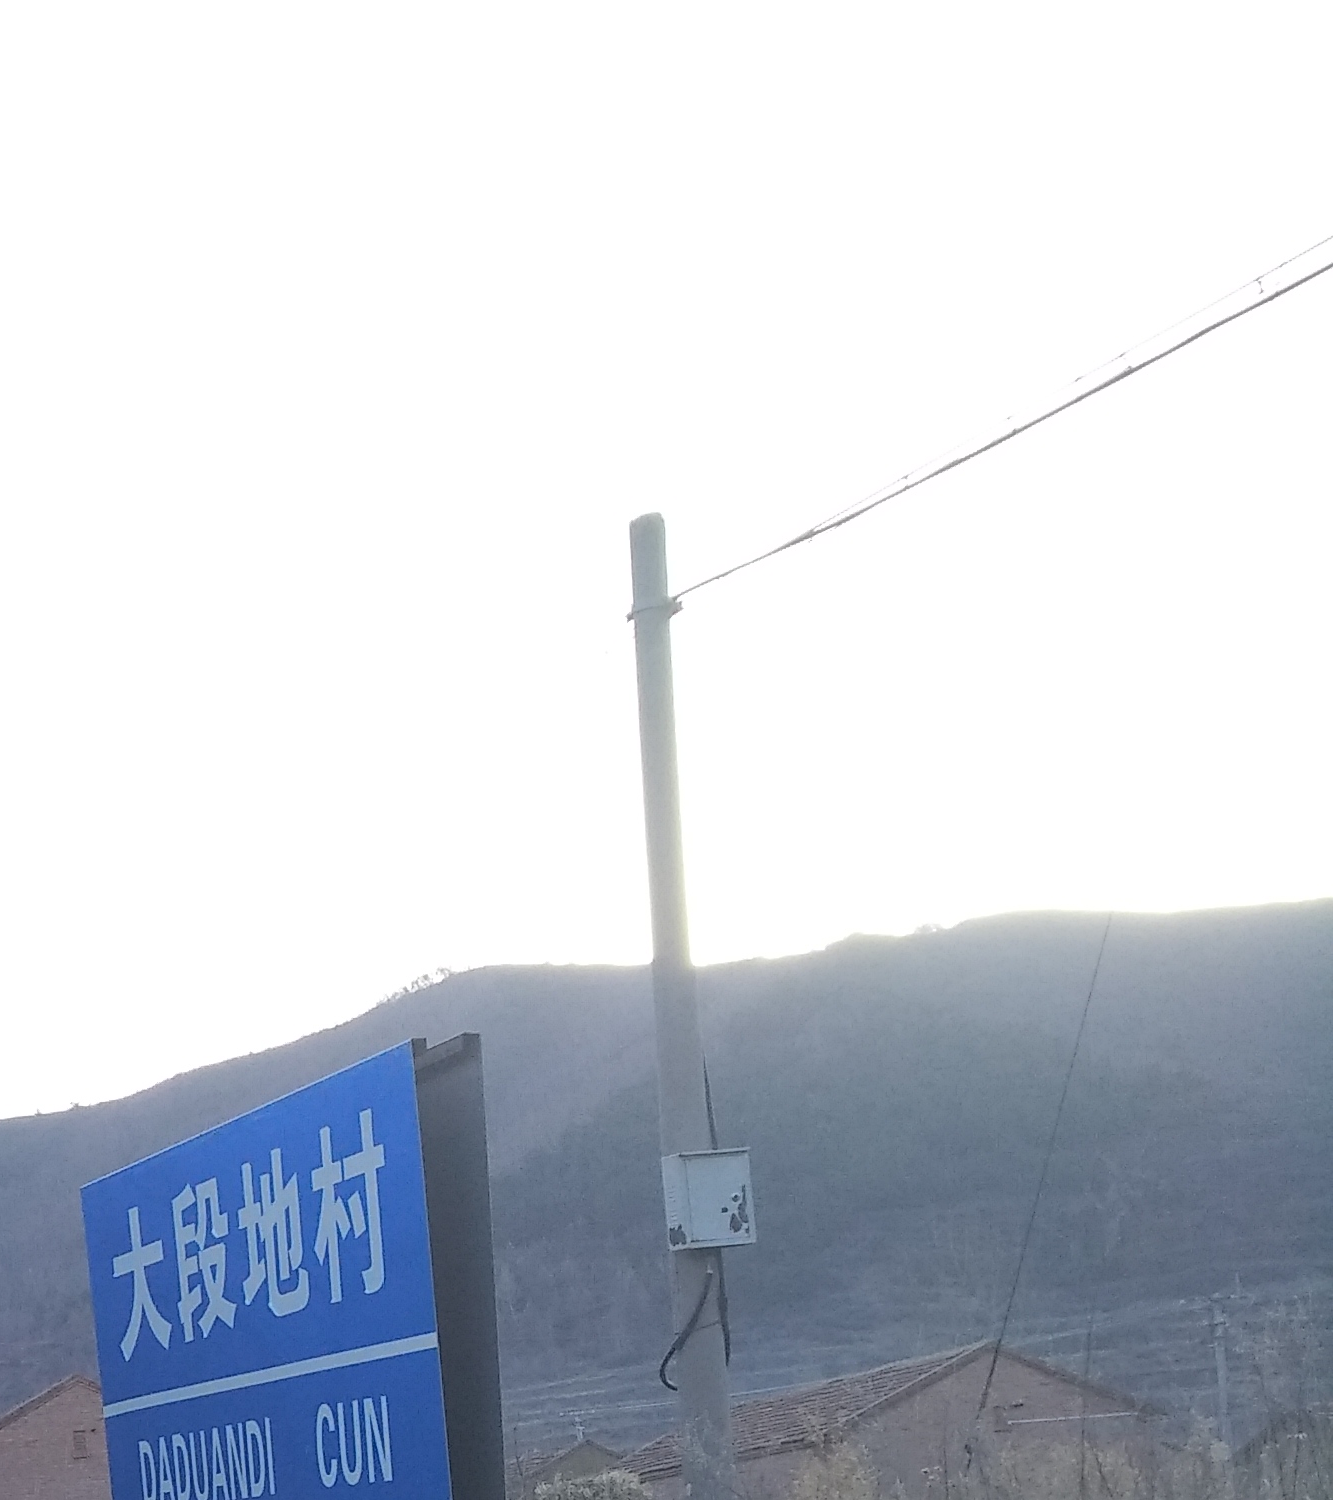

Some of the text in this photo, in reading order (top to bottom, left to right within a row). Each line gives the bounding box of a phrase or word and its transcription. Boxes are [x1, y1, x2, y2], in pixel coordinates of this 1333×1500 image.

[112, 1108, 385, 1362] 大段地村
[315, 1395, 393, 1489] CUN
